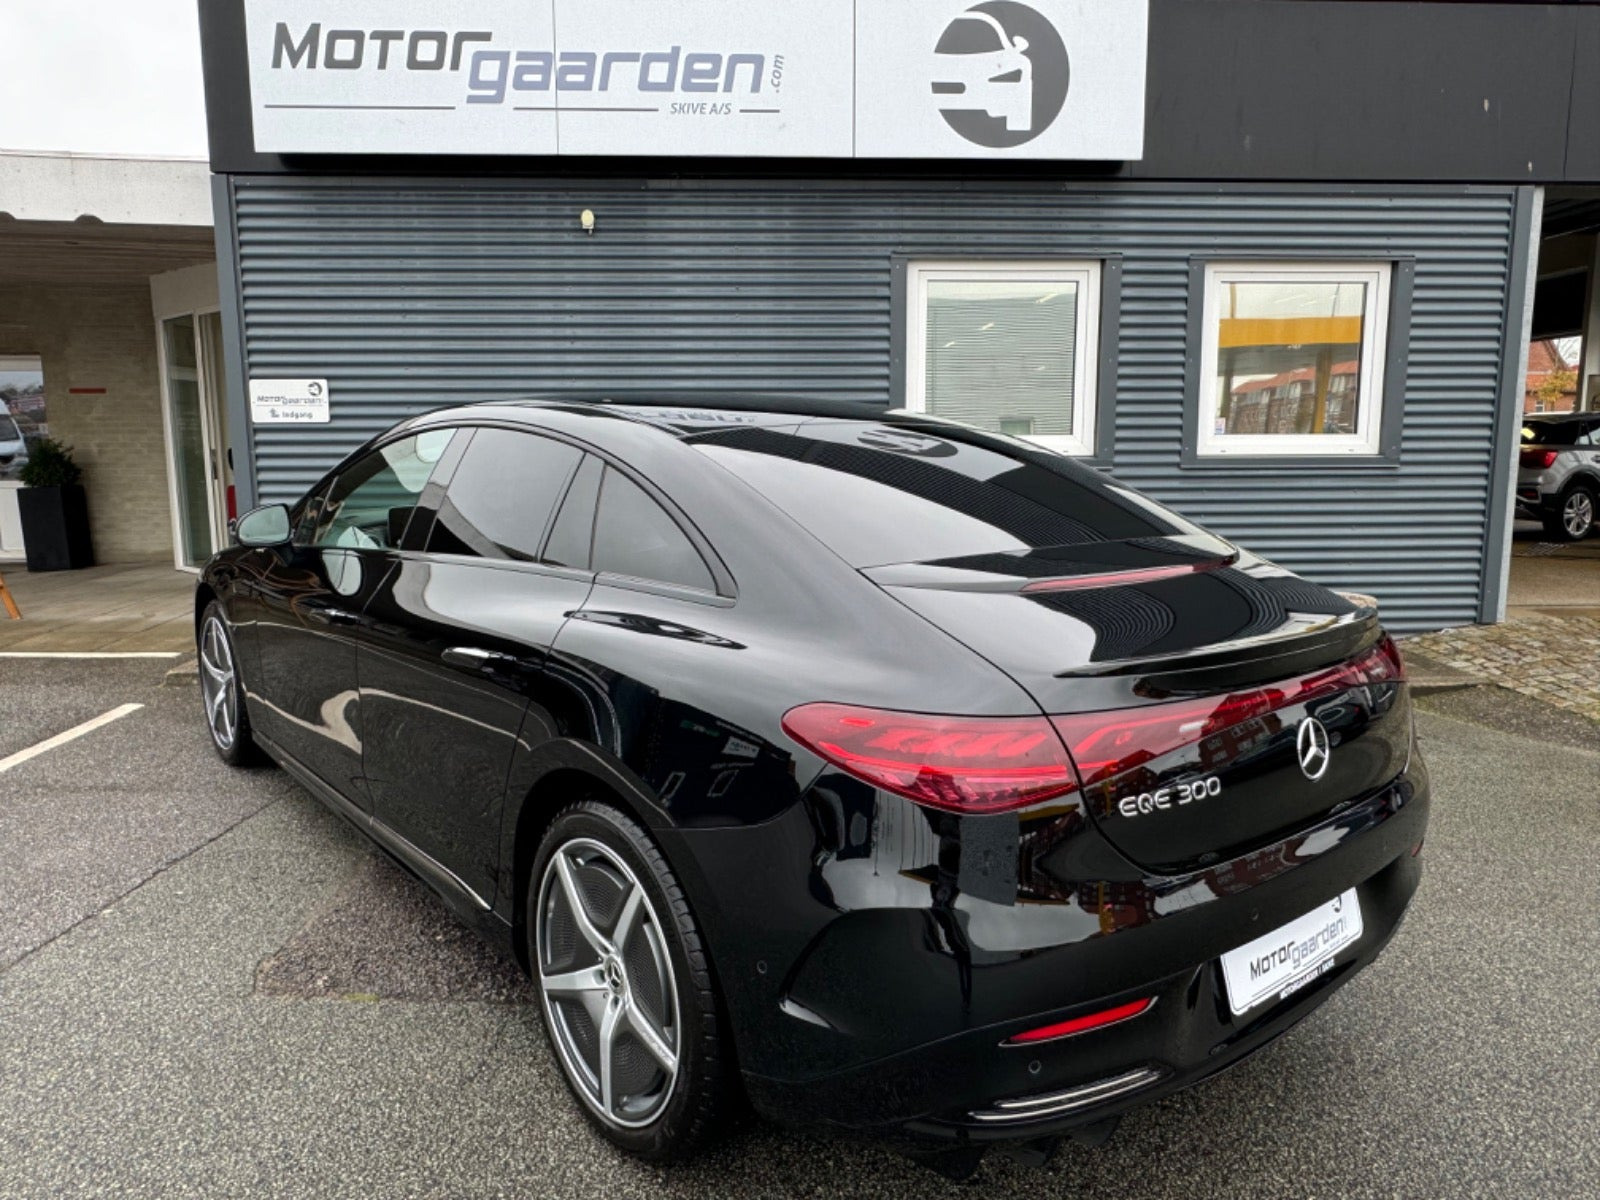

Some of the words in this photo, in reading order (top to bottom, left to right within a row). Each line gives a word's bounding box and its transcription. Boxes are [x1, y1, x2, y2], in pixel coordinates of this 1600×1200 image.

[670, 102, 708, 115] SKIVE
[709, 103, 733, 115] A/S
[1119, 788, 1171, 817] EQE
[1176, 776, 1222, 805] 300
